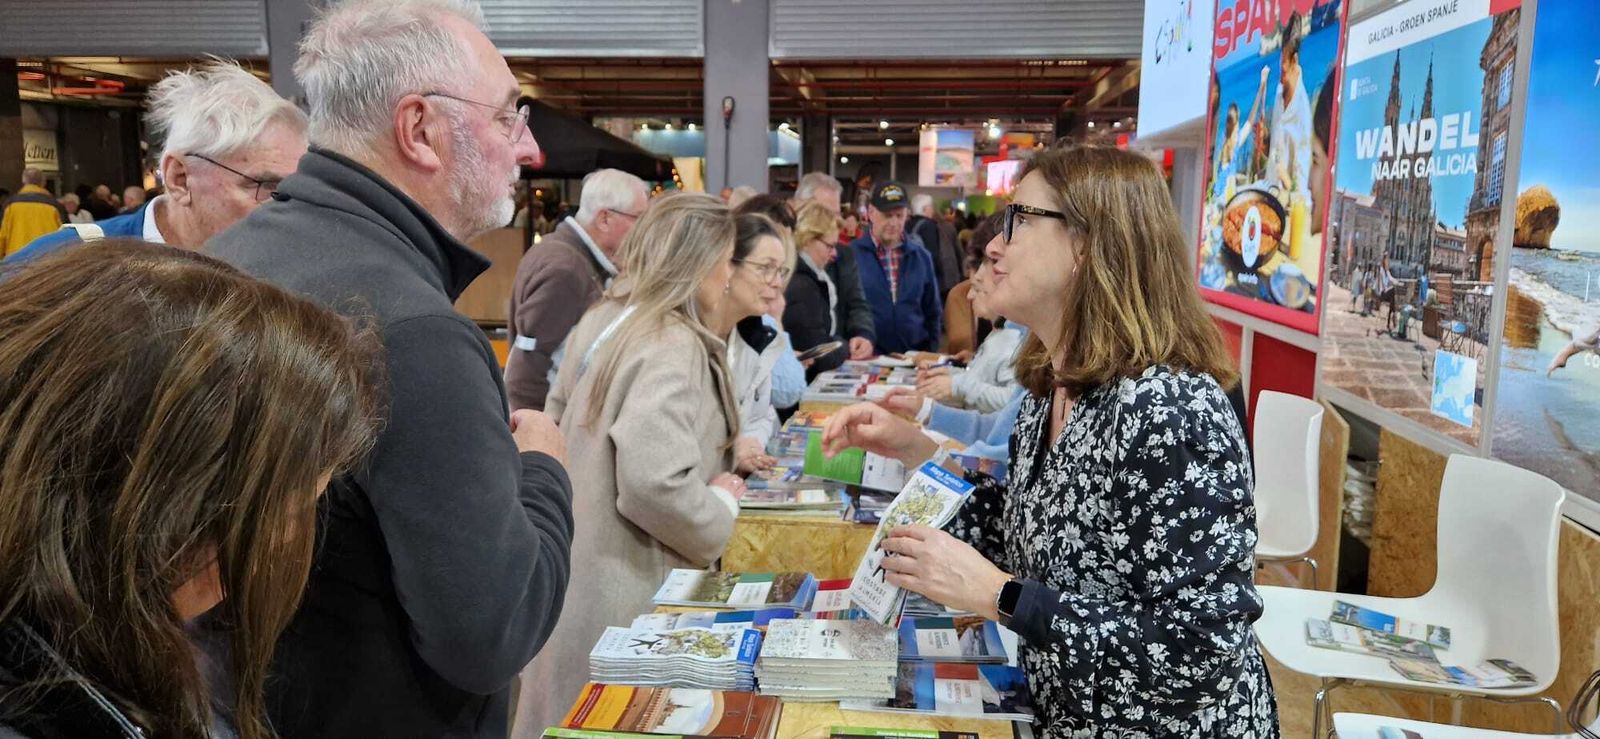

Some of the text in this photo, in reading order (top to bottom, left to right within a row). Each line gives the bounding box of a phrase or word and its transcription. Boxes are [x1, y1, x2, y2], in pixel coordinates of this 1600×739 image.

[1367, 26, 1395, 45] GALICIA
[1399, 14, 1426, 36] GROEN
[1426, 1, 1458, 23] SPANJE
[1356, 111, 1480, 160] WANDEL
[1371, 151, 1478, 180] NAAR GALICIA
